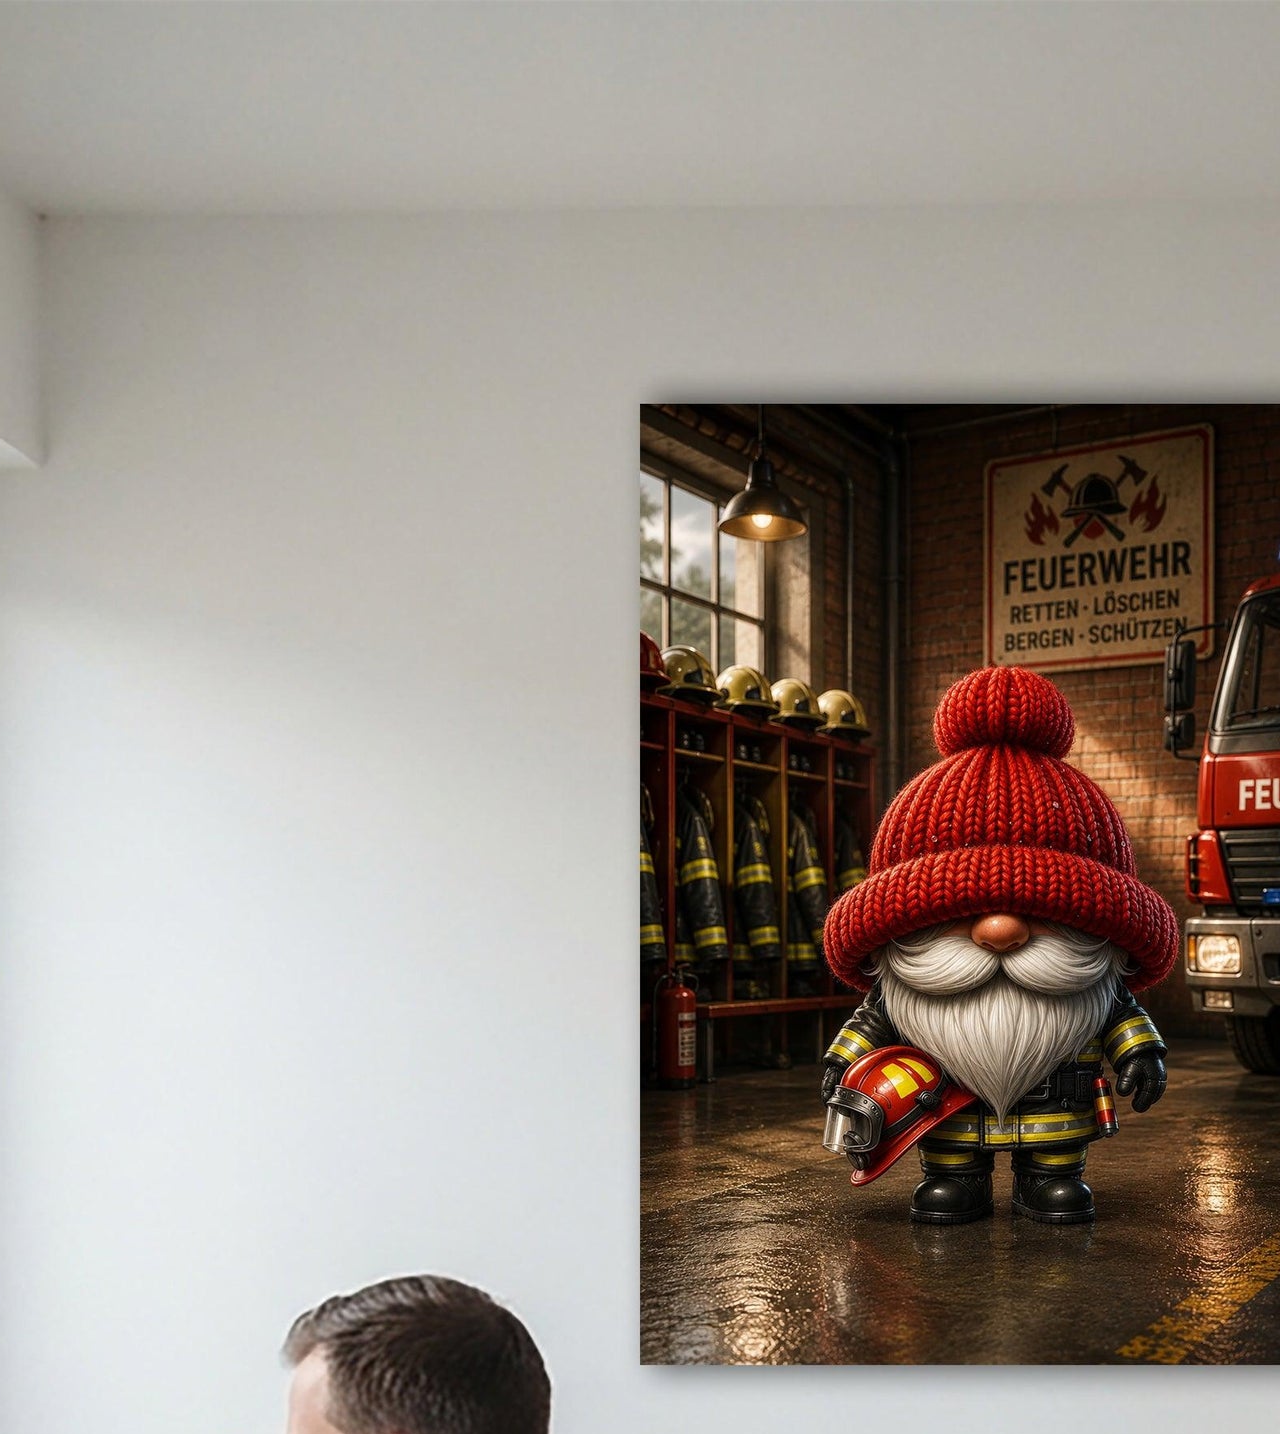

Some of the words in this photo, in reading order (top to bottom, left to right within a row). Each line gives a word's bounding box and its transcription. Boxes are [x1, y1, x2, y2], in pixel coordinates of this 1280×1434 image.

[1003, 540, 1193, 597] FEUERWEHR
[1010, 599, 1079, 625] RETTEN
[1093, 588, 1180, 616] LÖSCHEN
[1004, 627, 1074, 652] BERGEN
[1088, 616, 1188, 645] SCHÜTZEN
